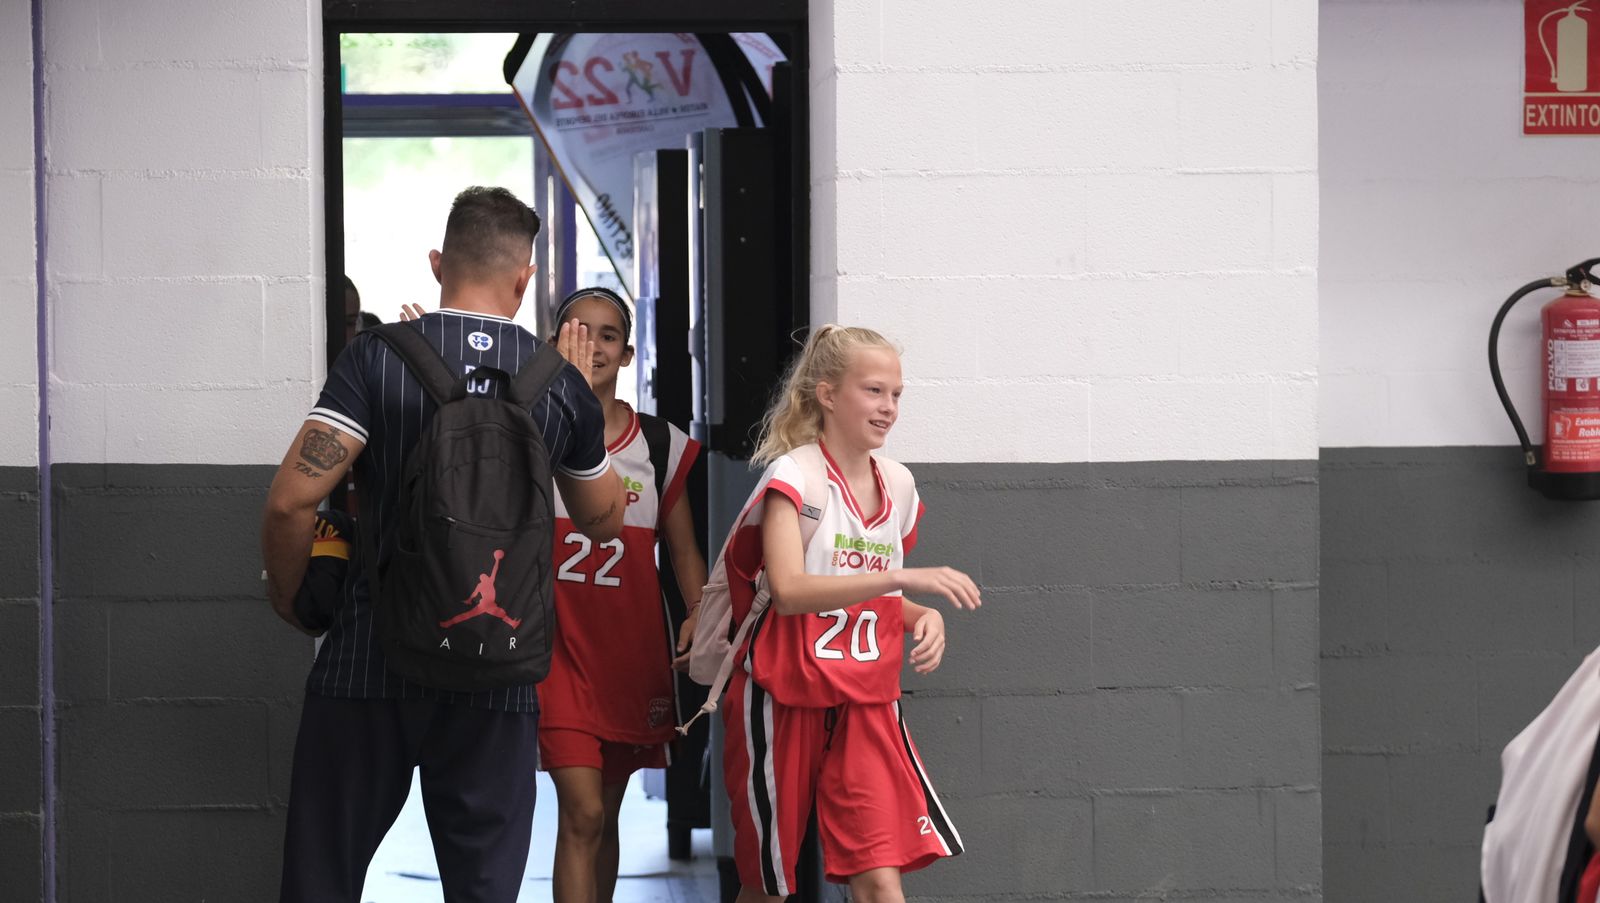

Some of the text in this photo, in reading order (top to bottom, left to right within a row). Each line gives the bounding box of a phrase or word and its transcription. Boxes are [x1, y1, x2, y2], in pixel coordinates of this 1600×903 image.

[1547, 338, 1555, 392] POLVO
[557, 532, 625, 587] 22
[839, 550, 890, 572] COVA
[440, 637, 516, 655] AIR
[814, 608, 881, 662] 20
